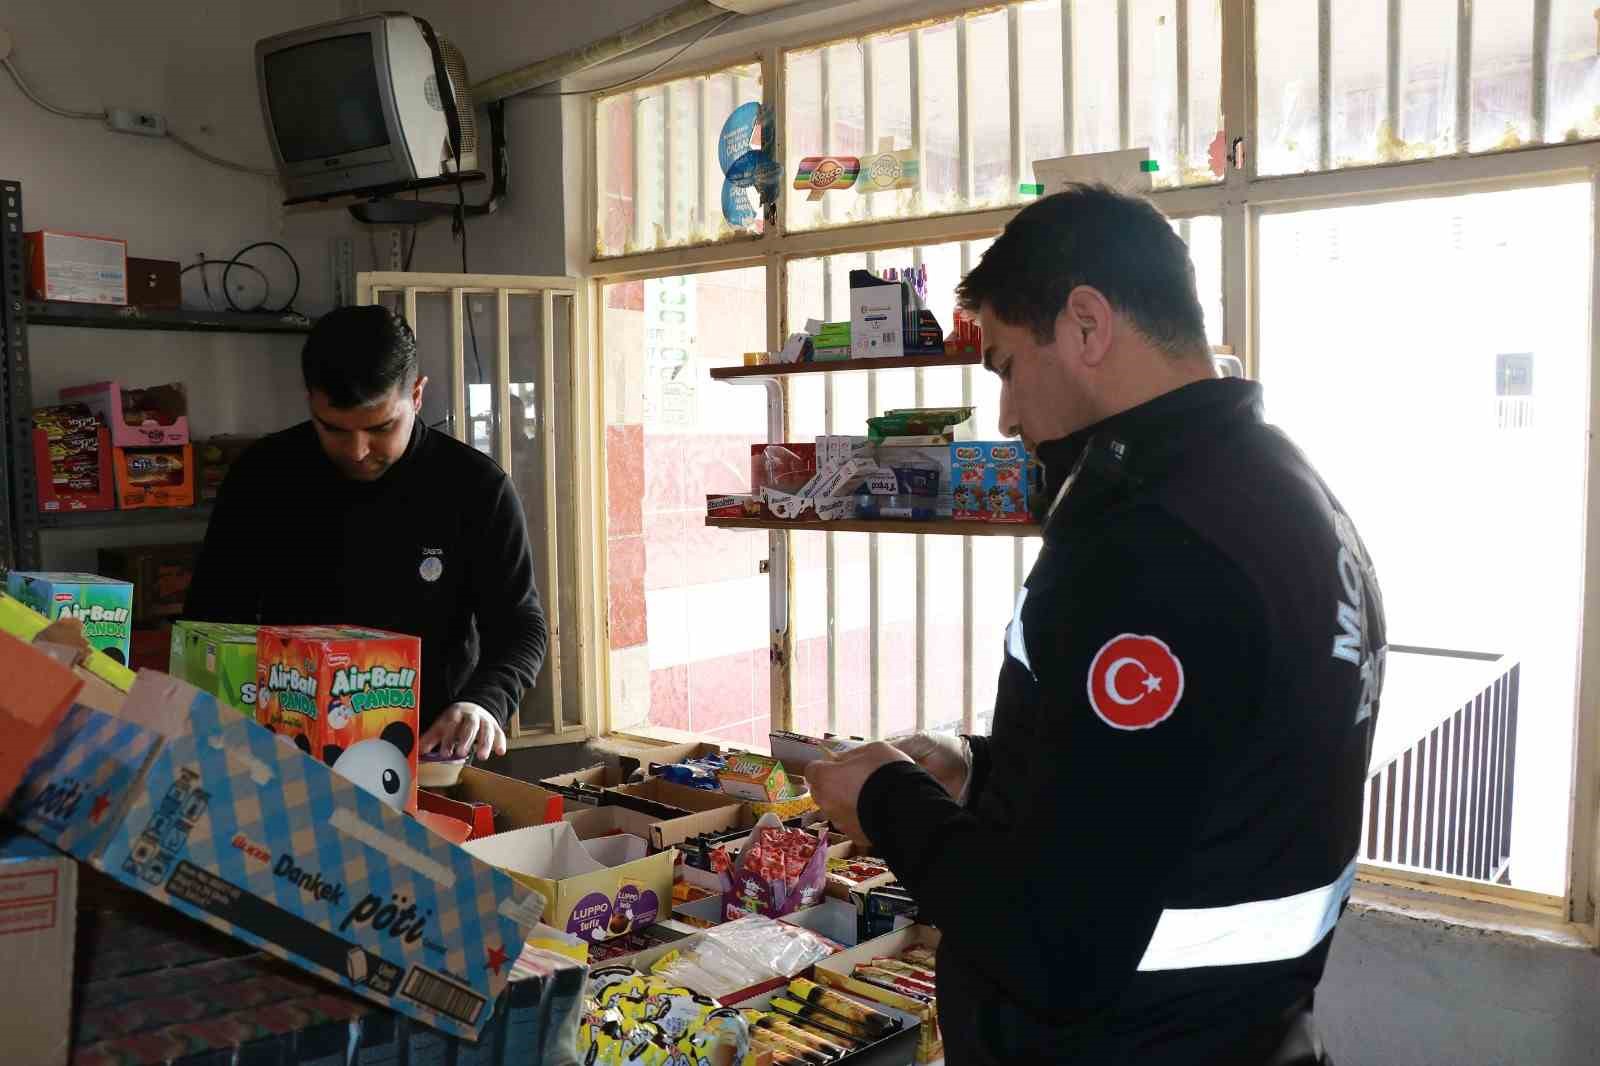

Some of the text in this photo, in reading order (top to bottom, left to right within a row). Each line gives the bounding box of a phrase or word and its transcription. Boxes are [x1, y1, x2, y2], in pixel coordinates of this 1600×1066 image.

[81, 621, 128, 638] ANDA
[240, 682, 257, 704] S
[268, 663, 318, 698] AirBall
[331, 665, 417, 696] AirBall
[278, 689, 318, 721] PANDA
[350, 688, 416, 714] PANDA
[272, 852, 345, 905] Dankek
[573, 902, 609, 921] LUPPO
